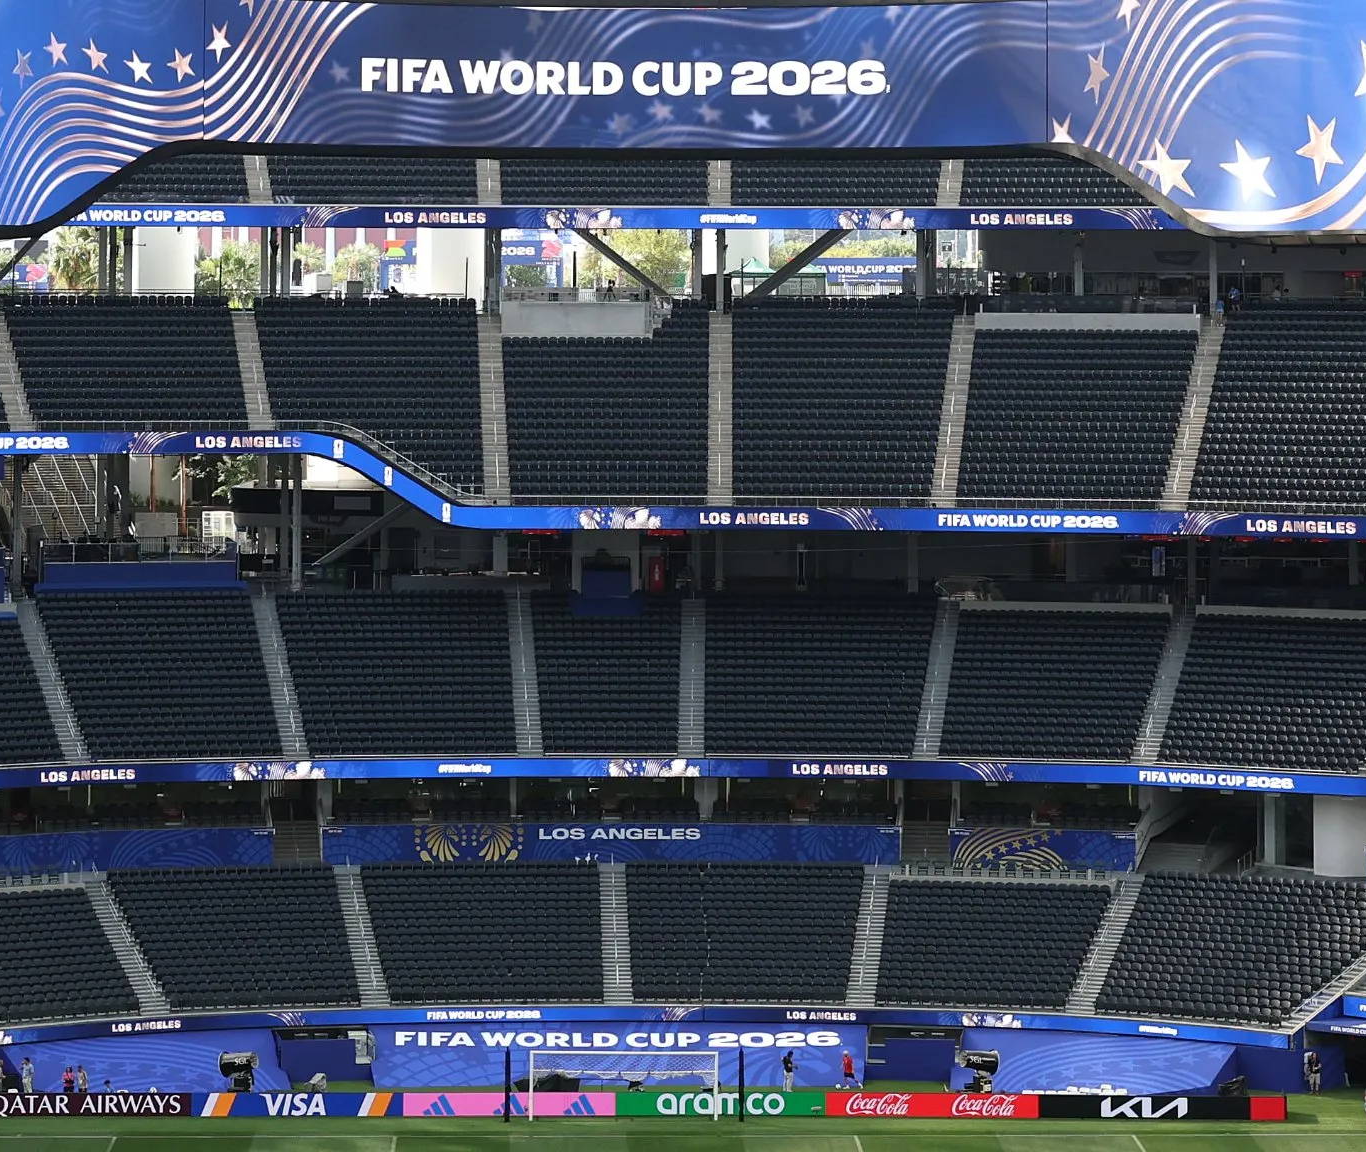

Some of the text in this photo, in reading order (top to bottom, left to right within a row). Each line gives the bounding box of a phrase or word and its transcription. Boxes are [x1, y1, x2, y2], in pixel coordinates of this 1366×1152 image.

[361, 57, 886, 97] FIFA WORLD CUP 2026
[89, 210, 141, 223] WORLD
[143, 210, 172, 223] CUP
[174, 210, 225, 223] 2026
[385, 212, 486, 224] LOS ANGELES
[970, 213, 1073, 226] LOS ANGELES
[16, 436, 68, 450] 2026
[195, 435, 302, 449] LOS ANGELES
[699, 512, 809, 526] LOS ANGELES
[938, 514, 1117, 529] FIFA WORLD CUP 2026
[1246, 519, 1357, 535] LOS ANGELES
[40, 768, 135, 783] LOS ANGELES
[792, 763, 888, 776] LOS ANGELES
[1138, 770, 1293, 789] FIFA WORLD CUP 2026
[538, 828, 701, 841] LOS ANGELES
[427, 1010, 541, 1020] FIFA WORLD CUP 2026
[787, 1011, 856, 1021] LOS ANGELES
[112, 1020, 181, 1033] LOS ANGELES
[395, 1031, 841, 1047] FIFA WORLD CUP 2026
[80, 1095, 181, 1115] AIRWAYS
[260, 1093, 326, 1116] VISA
[657, 1093, 784, 1115] aramco
